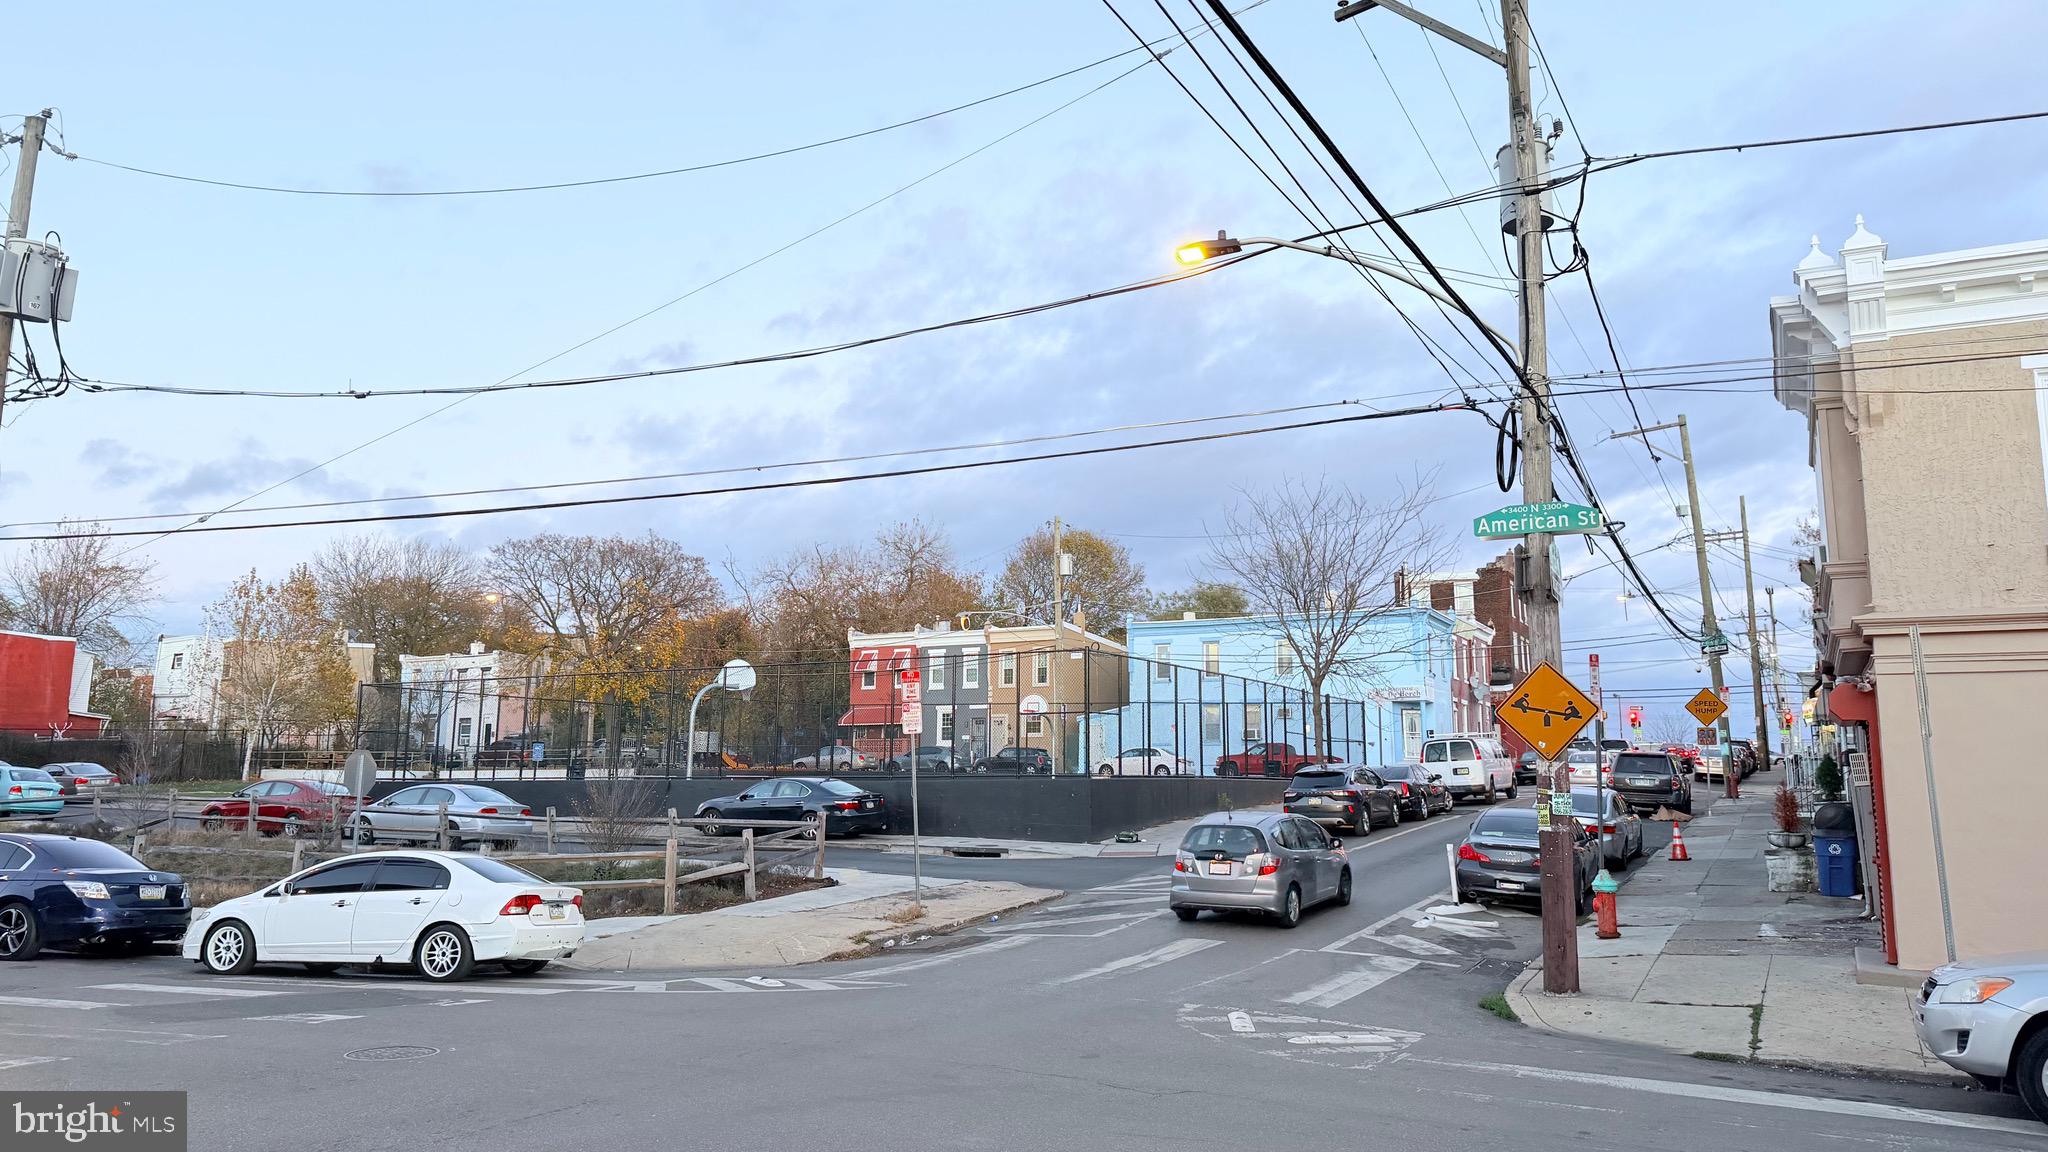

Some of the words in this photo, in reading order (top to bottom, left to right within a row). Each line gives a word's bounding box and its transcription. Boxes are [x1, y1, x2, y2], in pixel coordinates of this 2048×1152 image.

[1508, 506, 1528, 514] 3400
[1531, 505, 1539, 513] N
[1542, 503, 1562, 511] 3300
[1478, 514, 1569, 533] American
[1578, 511, 1596, 526] St
